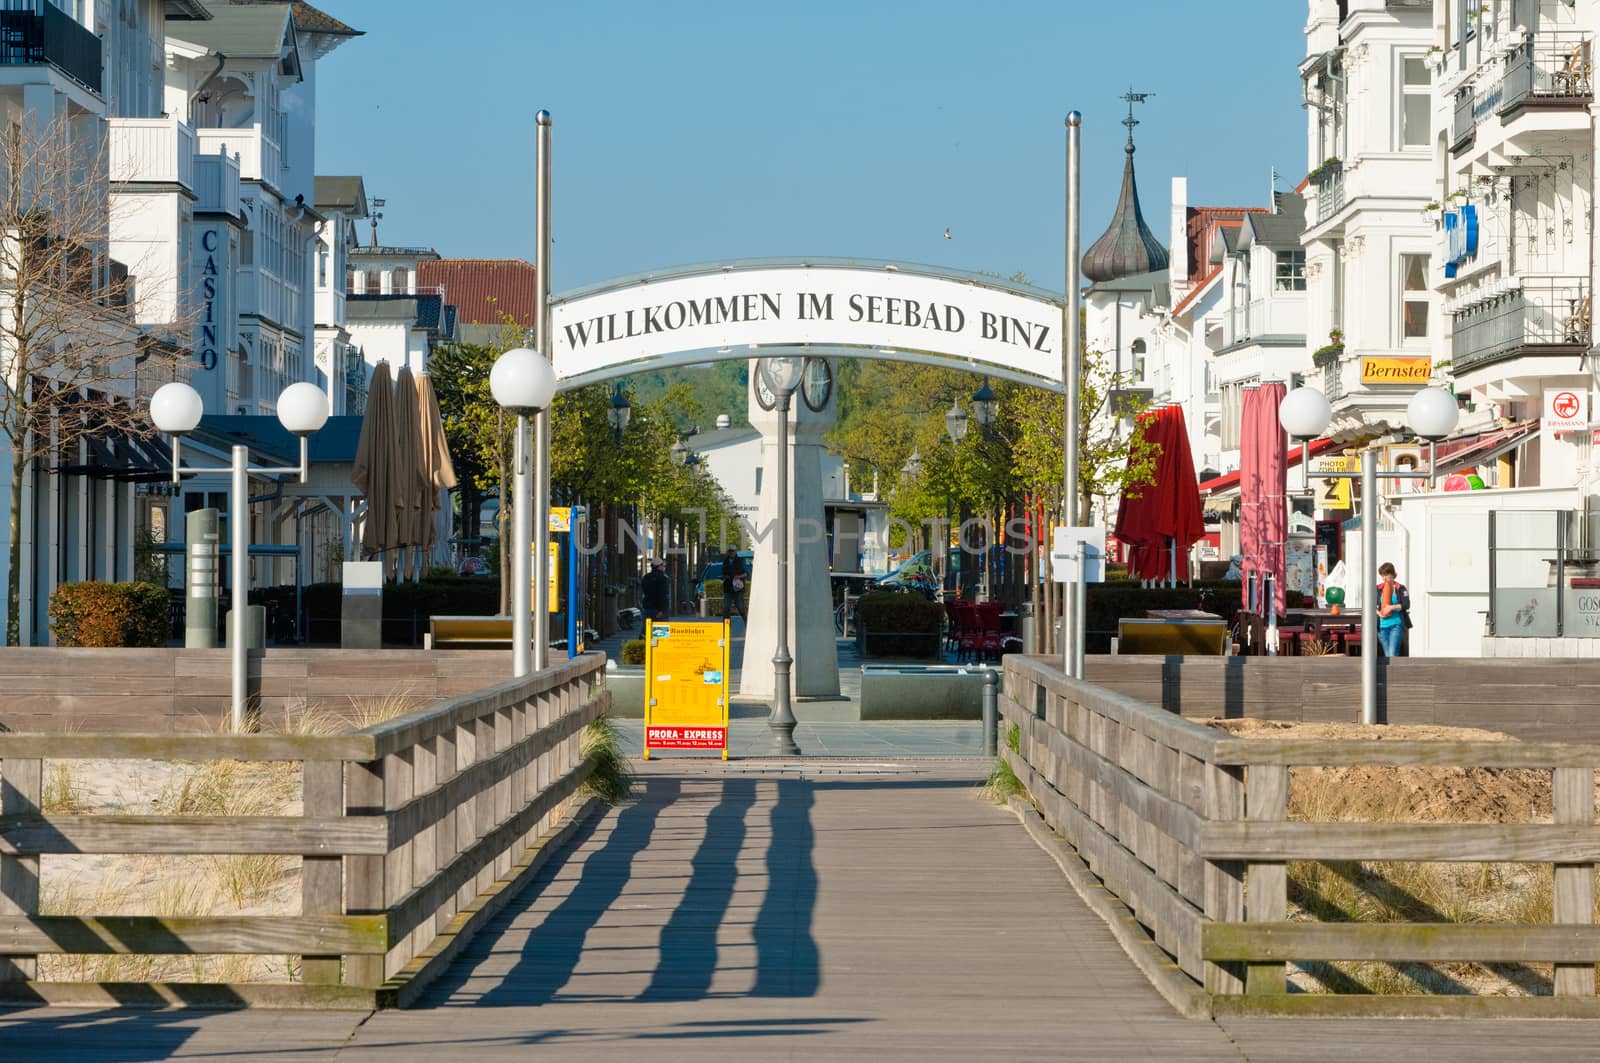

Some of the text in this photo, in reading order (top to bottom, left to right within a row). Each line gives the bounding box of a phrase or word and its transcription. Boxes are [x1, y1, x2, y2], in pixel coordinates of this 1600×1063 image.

[201, 230, 217, 371] CASINO
[563, 293, 1052, 353] WILLKOMMEN IM SEEBAD BINZ
[1579, 596, 1600, 611] GOS
[649, 730, 678, 739] PRORA
[684, 730, 722, 739] EXPRESS
